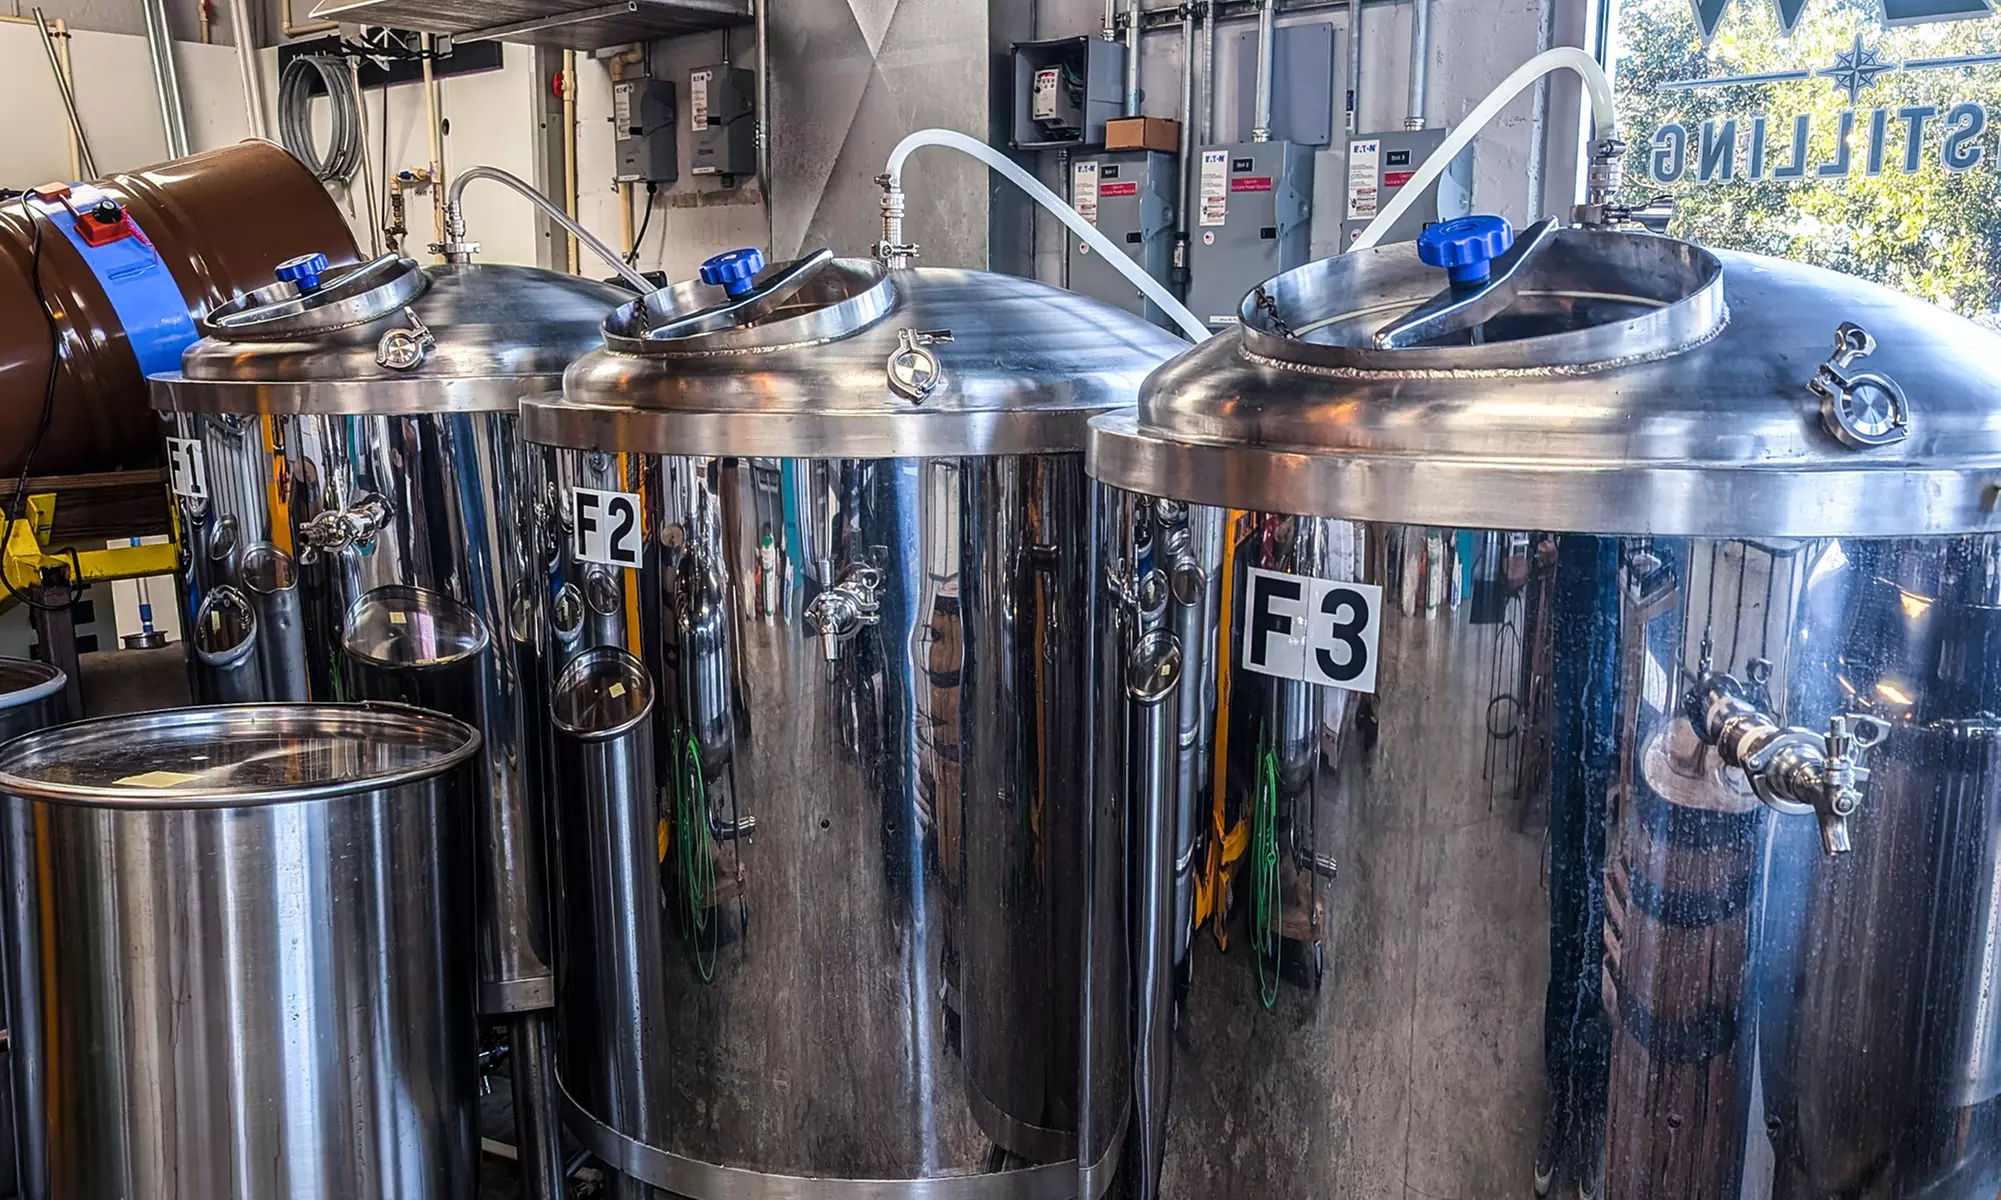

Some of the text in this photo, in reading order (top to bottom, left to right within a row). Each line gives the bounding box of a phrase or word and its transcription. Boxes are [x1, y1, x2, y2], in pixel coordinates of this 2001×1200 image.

[168, 440, 202, 495] F1
[576, 491, 637, 563] F2
[1250, 574, 1370, 682] F3
